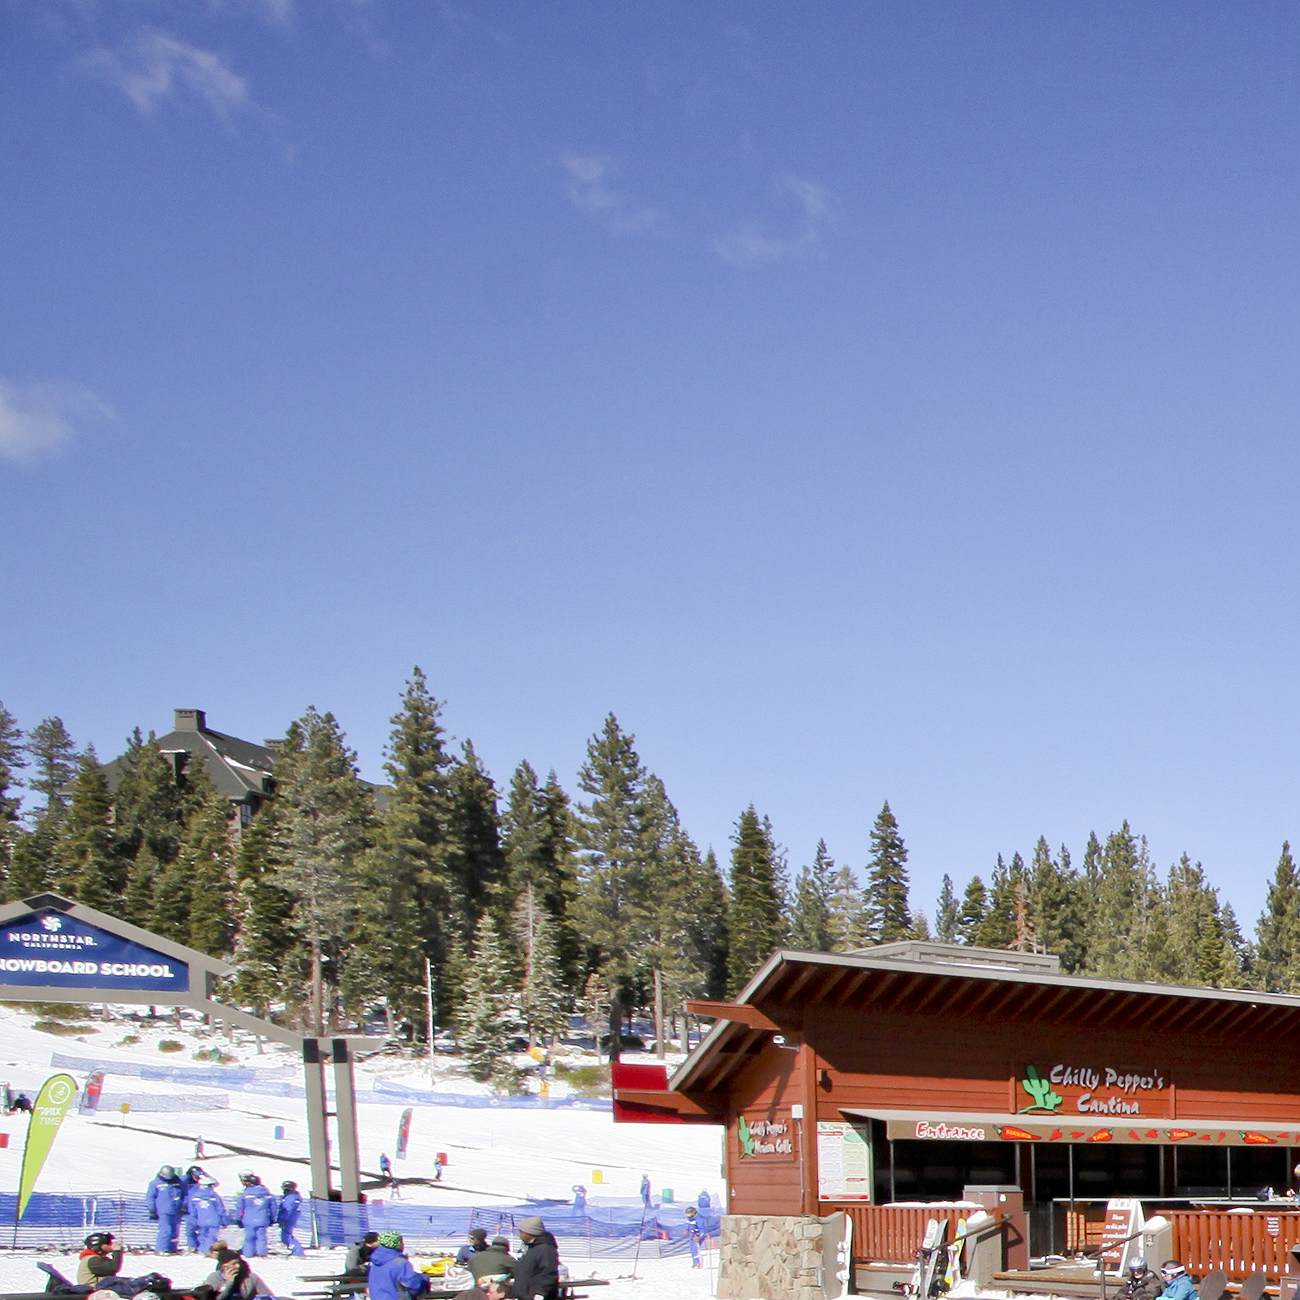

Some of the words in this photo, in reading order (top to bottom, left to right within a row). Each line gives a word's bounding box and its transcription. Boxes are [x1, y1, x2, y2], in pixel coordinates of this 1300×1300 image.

[8, 932, 96, 946] NORTHSTAR
[24, 942, 82, 950] CALIFORNIA
[0, 958, 98, 975] NOWBOARD
[100, 962, 175, 978] SCHOOL
[1050, 1064, 1100, 1090] Chilly
[1105, 1067, 1164, 1093] Pepper's
[1077, 1093, 1140, 1114] Cantina
[916, 1121, 986, 1141] Entrance
